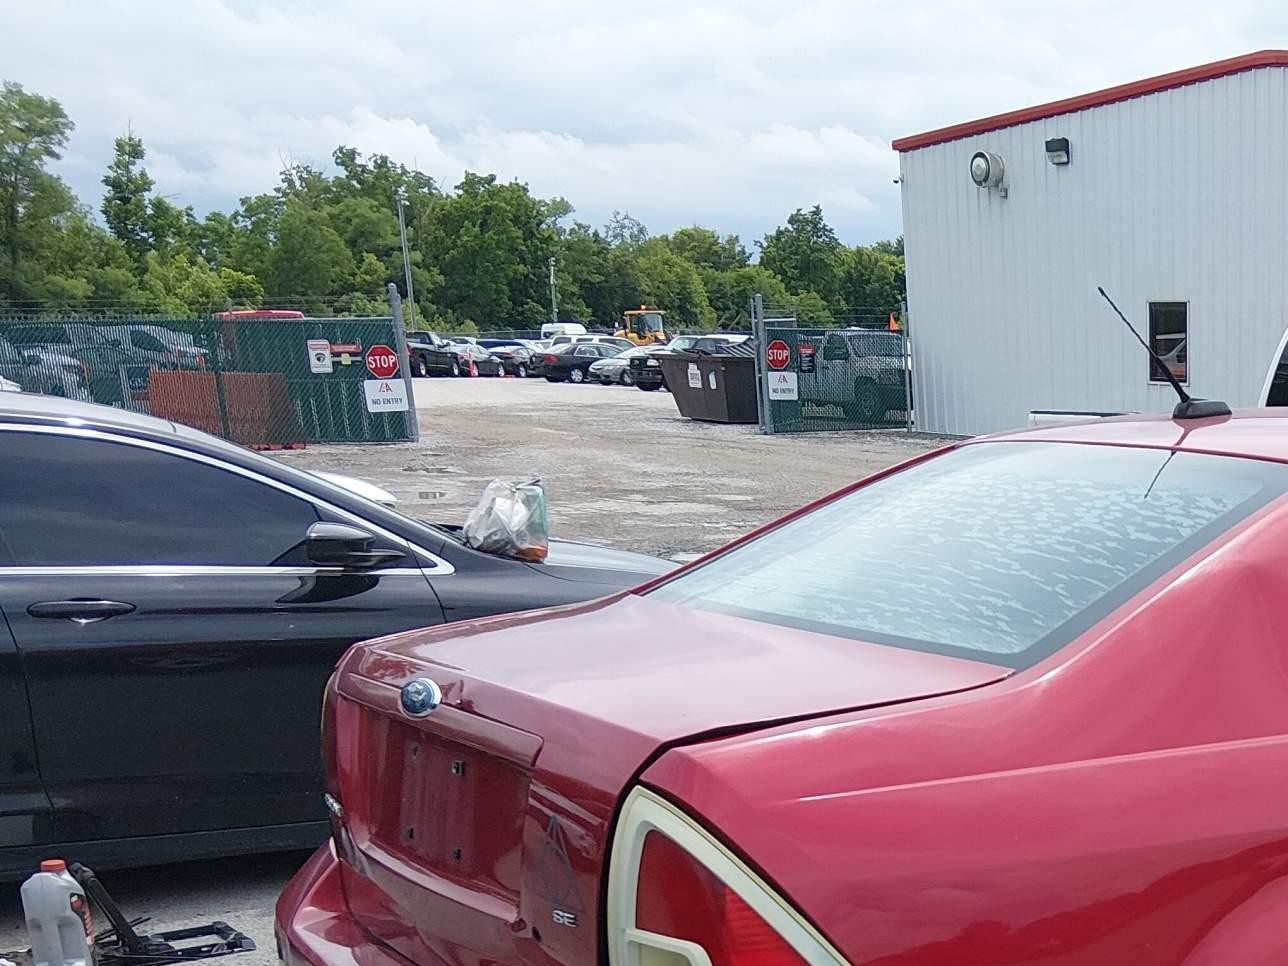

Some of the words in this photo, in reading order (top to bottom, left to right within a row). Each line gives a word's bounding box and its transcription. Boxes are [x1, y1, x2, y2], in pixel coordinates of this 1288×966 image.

[768, 350, 788, 360] STOP
[368, 355, 396, 369] STOP
[372, 398, 382, 406] NO
[552, 910, 577, 928] SE
